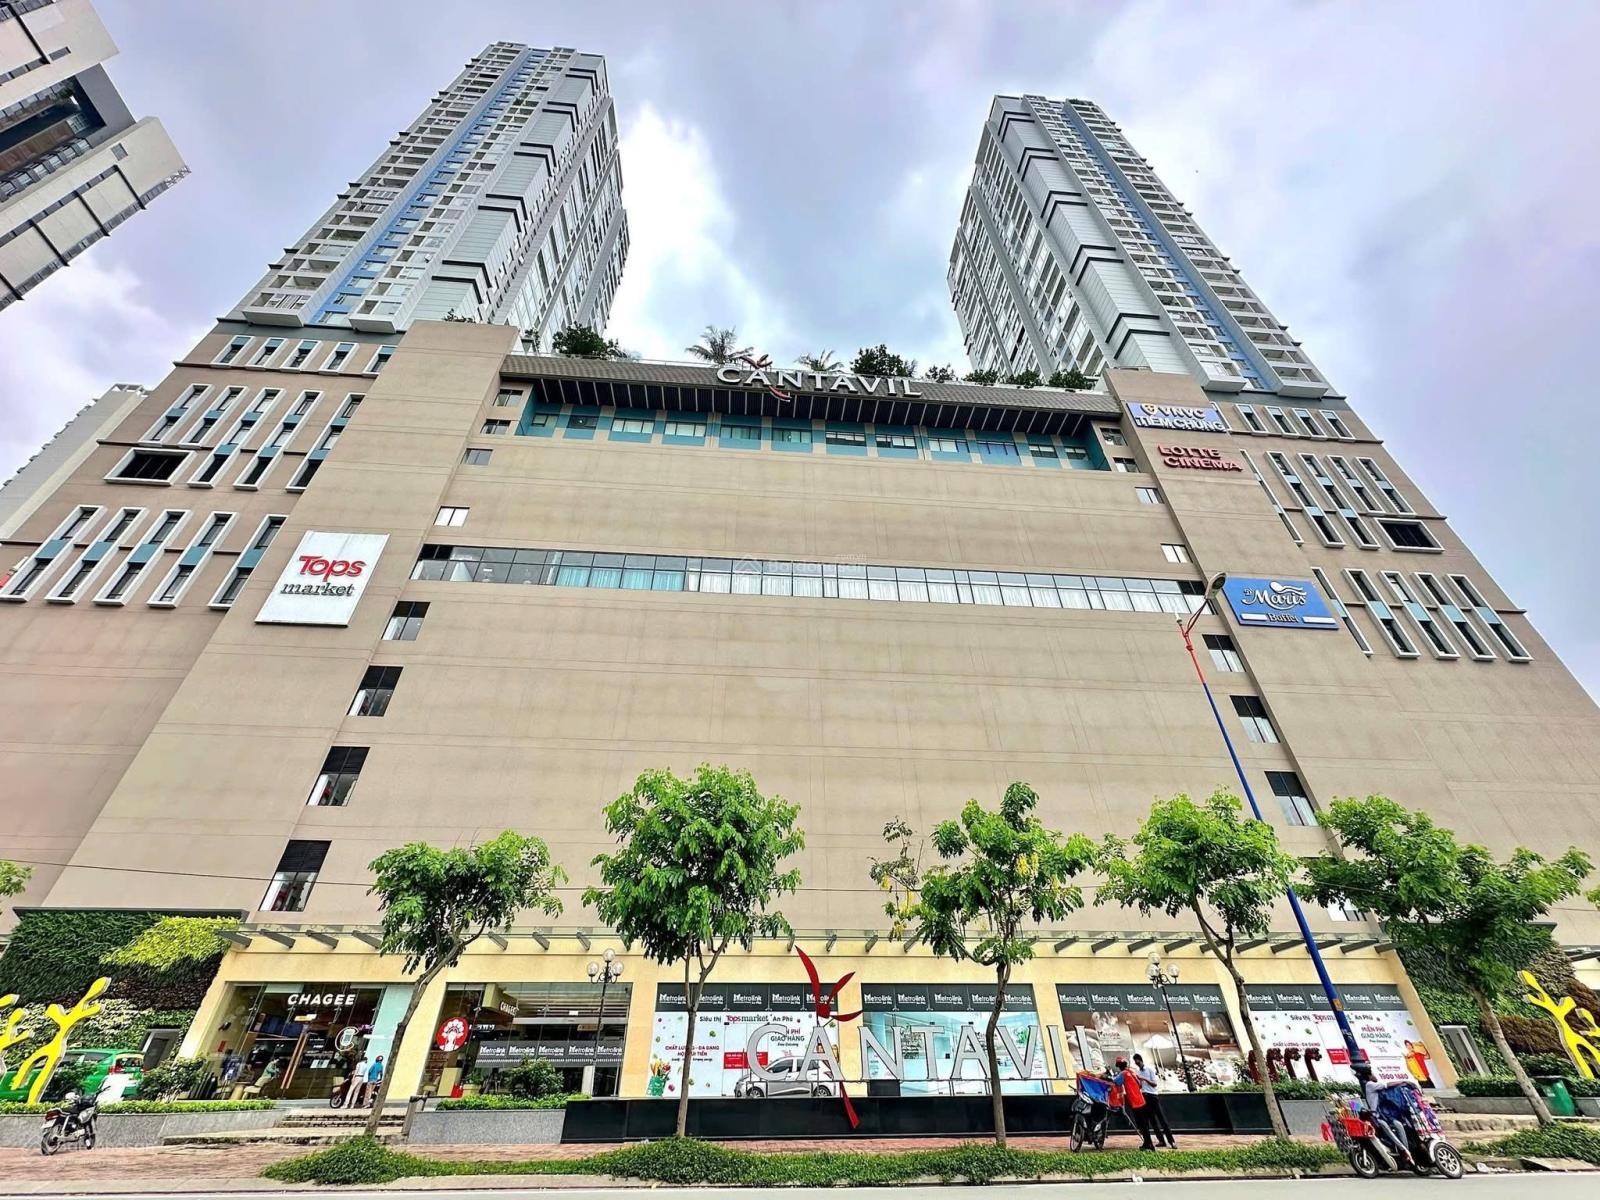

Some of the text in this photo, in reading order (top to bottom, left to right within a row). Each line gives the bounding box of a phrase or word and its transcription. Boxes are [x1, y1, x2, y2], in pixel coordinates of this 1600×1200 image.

[716, 366, 923, 397] CANTAVIL
[1158, 406, 1206, 419] VNVC
[1158, 444, 1221, 458] LOTTE
[1164, 457, 1243, 471] CINEMA
[299, 555, 366, 582] Tops
[280, 582, 355, 597] market
[287, 994, 356, 1005] CHAGEE
[747, 1024, 1095, 1081] CANTAVIL
